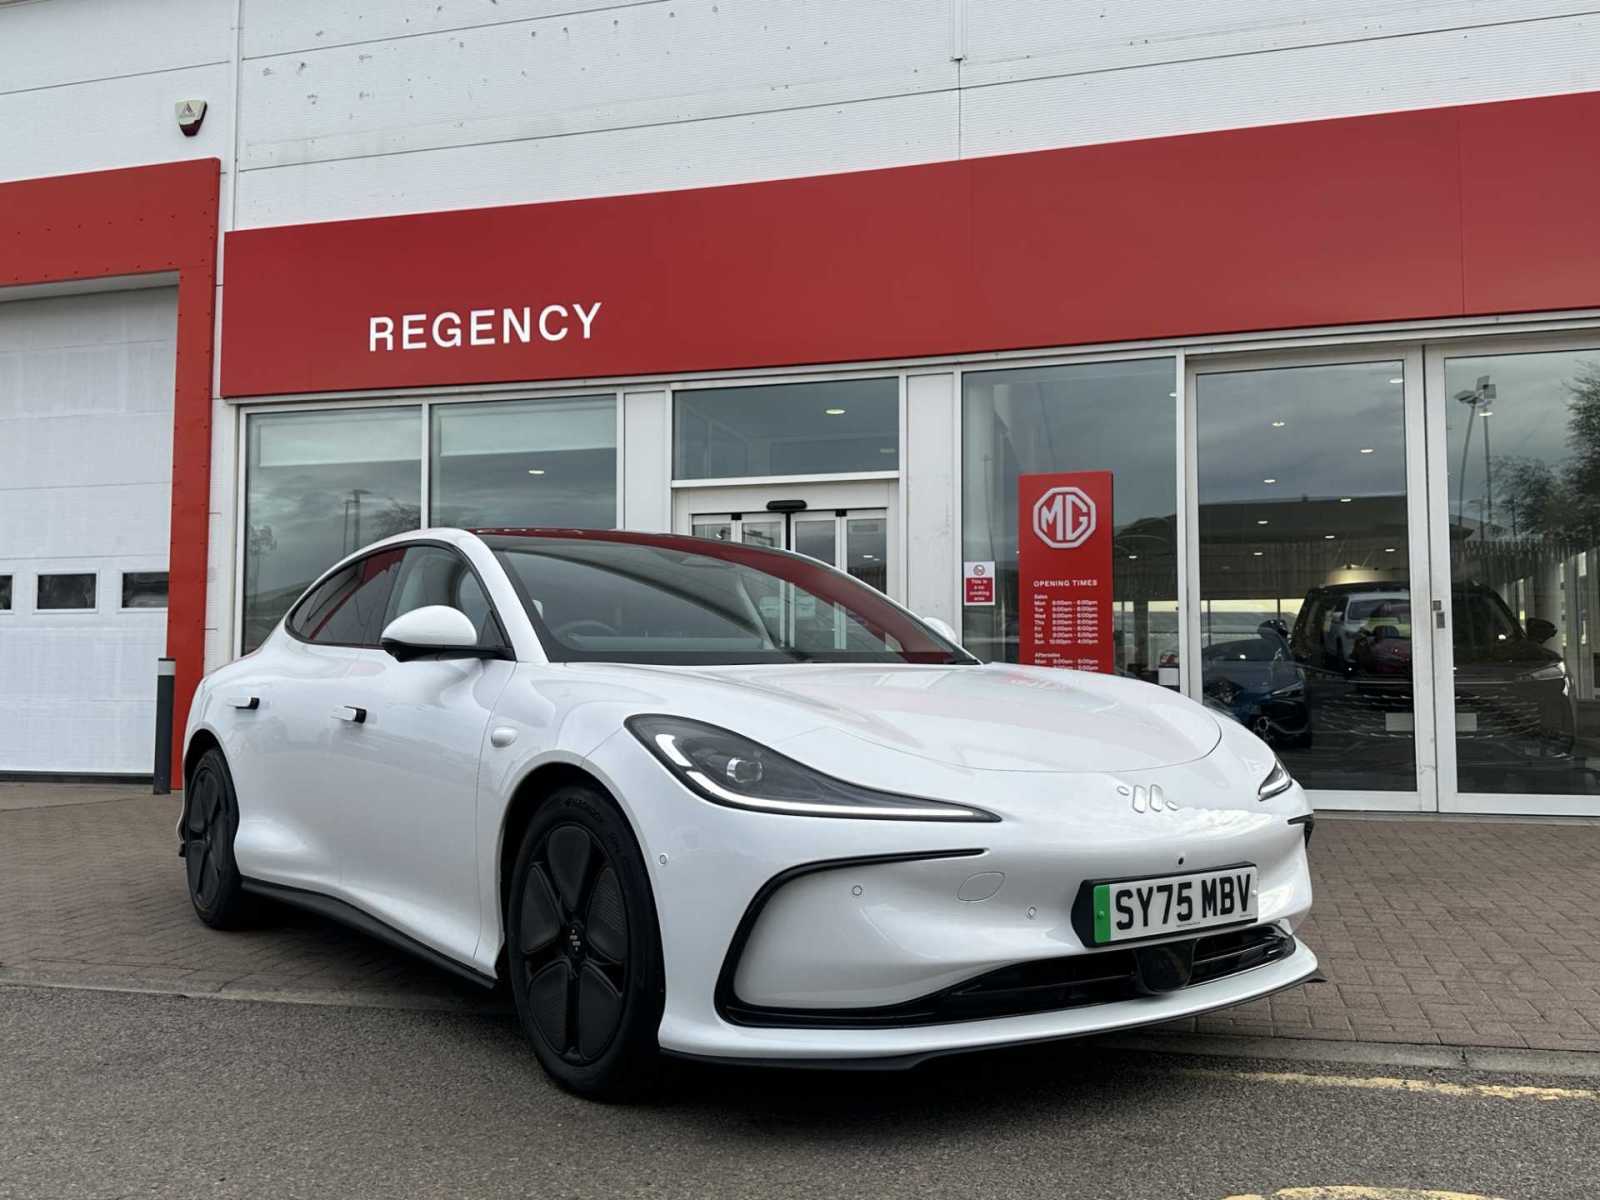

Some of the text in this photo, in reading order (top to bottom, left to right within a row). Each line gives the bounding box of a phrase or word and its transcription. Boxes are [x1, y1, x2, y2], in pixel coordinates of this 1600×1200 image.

[369, 302, 602, 352] REGENCY
[1041, 494, 1088, 541] MG
[1033, 579, 1098, 587] OPENING TIMES
[1116, 874, 1250, 930] SY75 MBV
